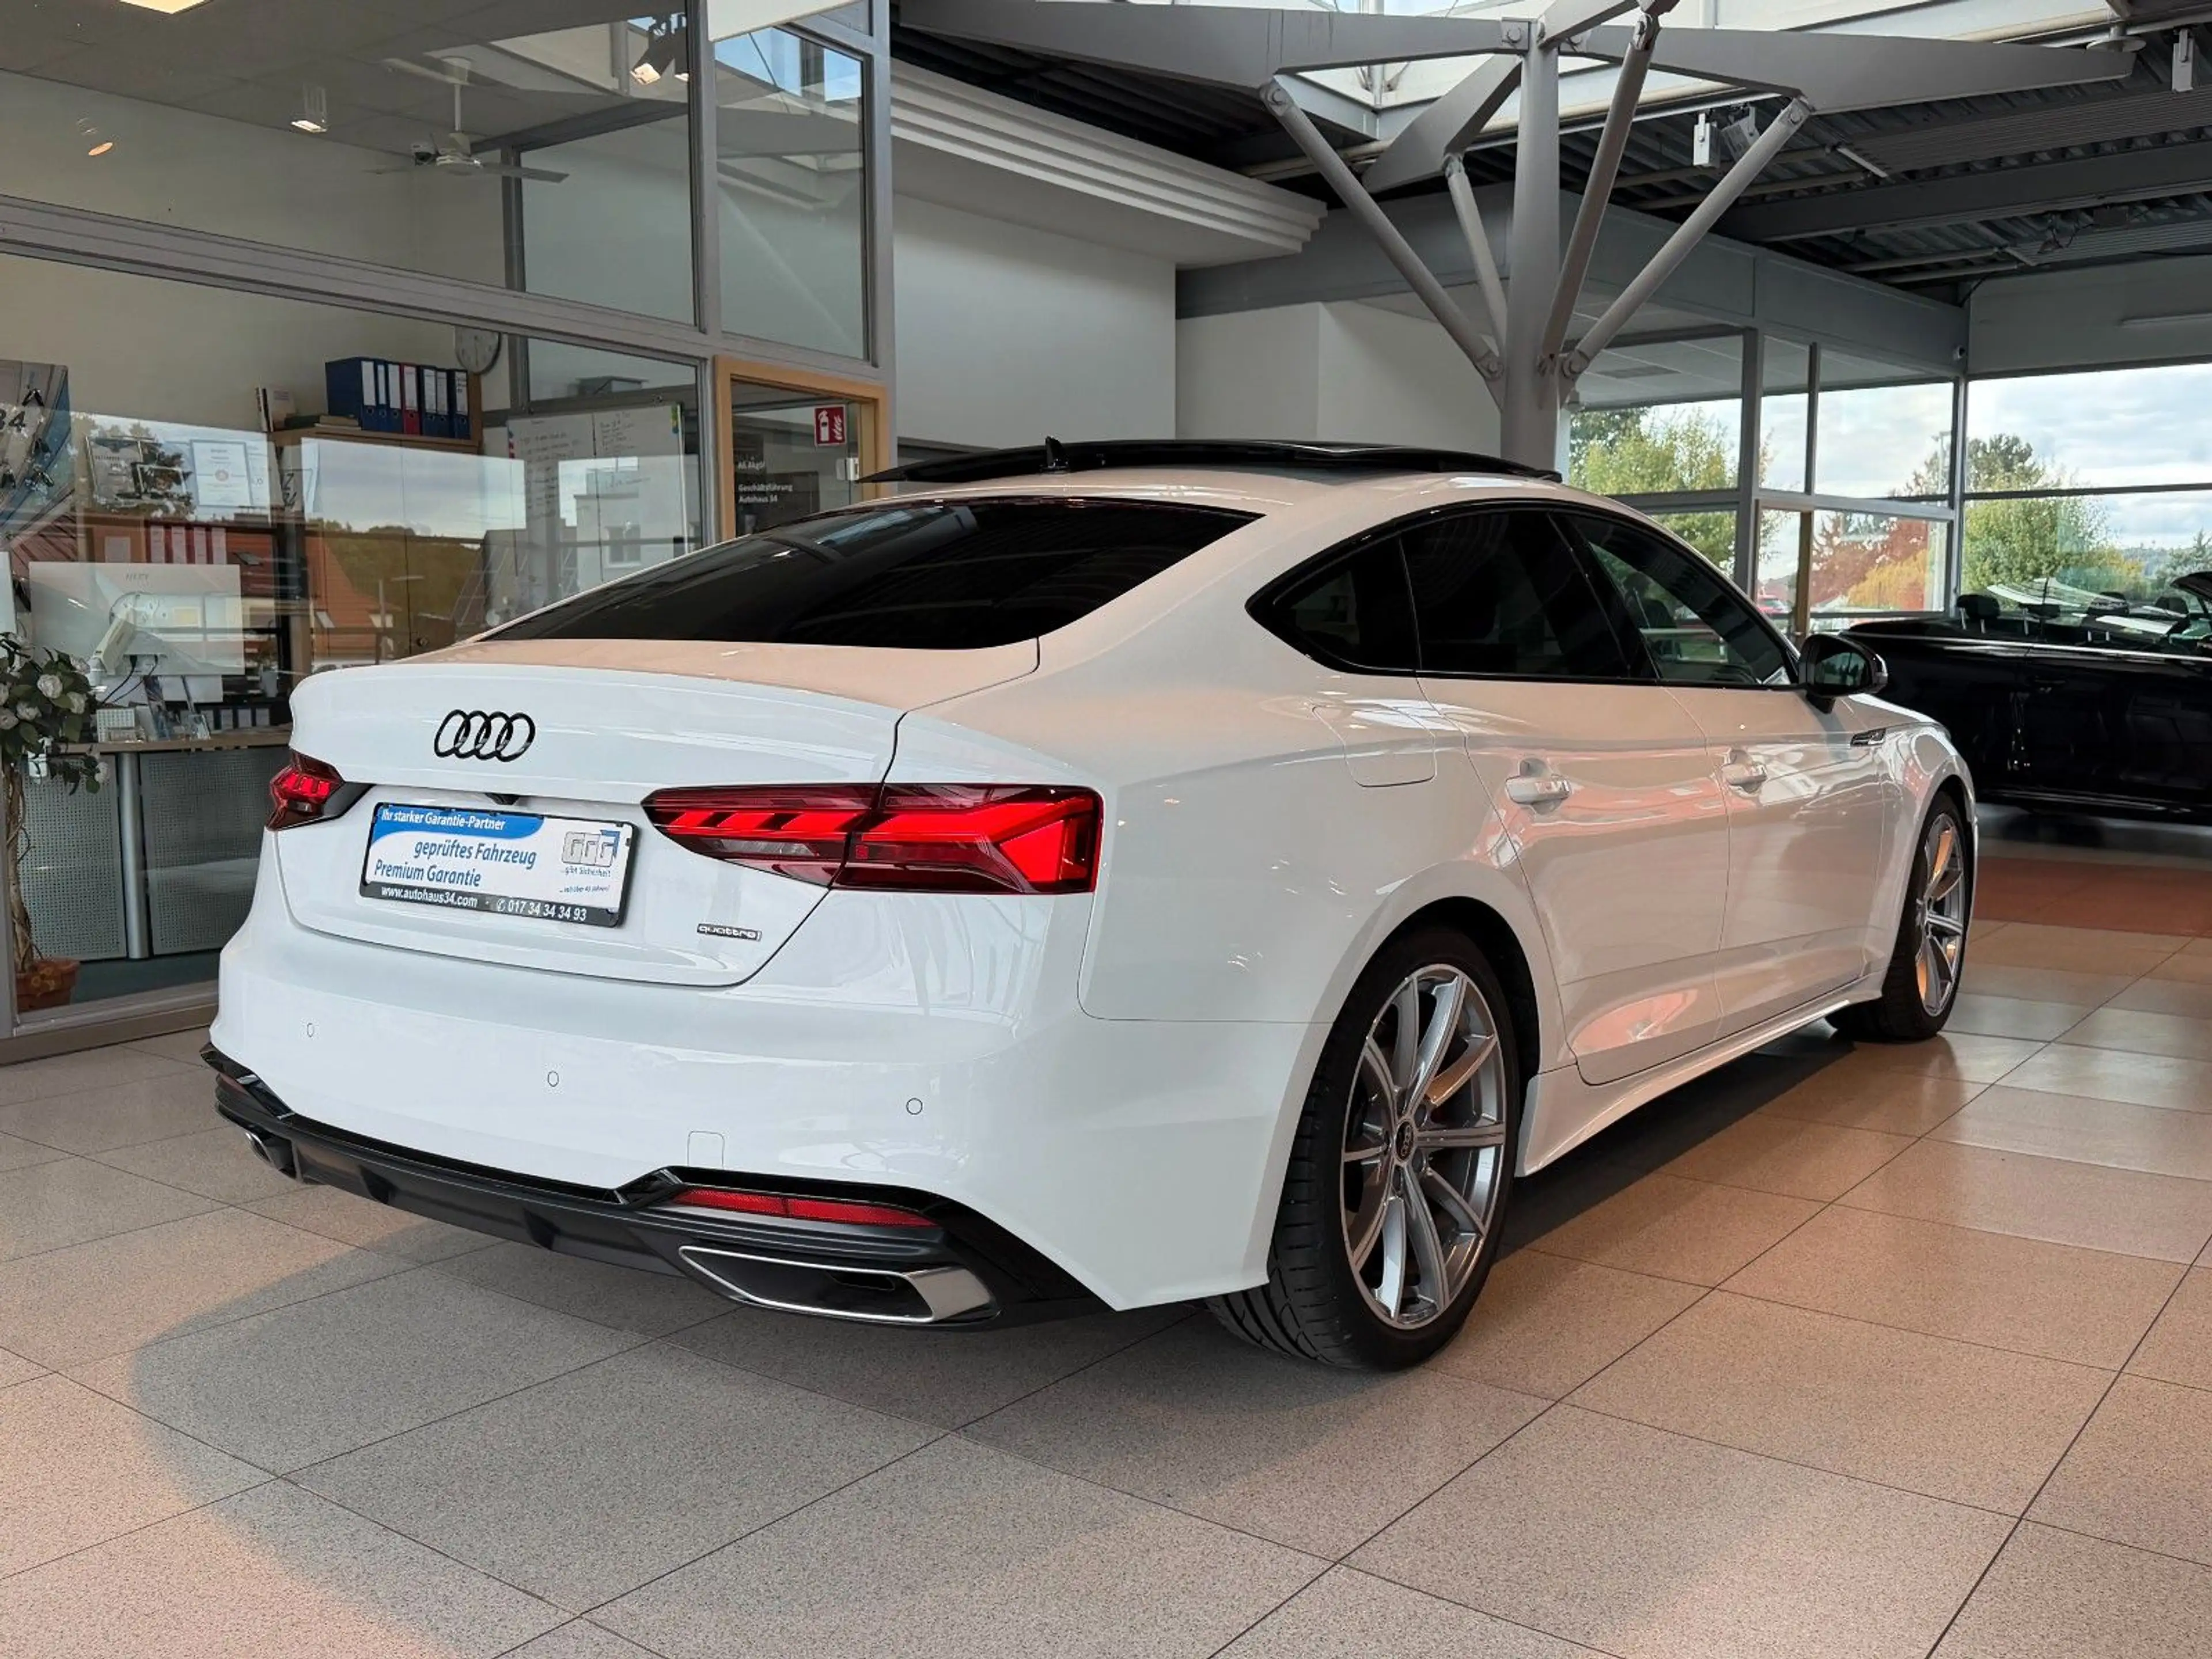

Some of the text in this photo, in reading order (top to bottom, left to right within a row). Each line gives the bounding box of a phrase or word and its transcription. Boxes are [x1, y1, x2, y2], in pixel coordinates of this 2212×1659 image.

[381, 809, 506, 831] Ihr starker Garantie-Partner
[414, 839, 537, 870] geprüftes Fahrzeug
[374, 858, 482, 887] Premium Garantie
[381, 886, 587, 921] www.autohaus34.com 017 34 34 34 93
[698, 925, 757, 939] quattro
